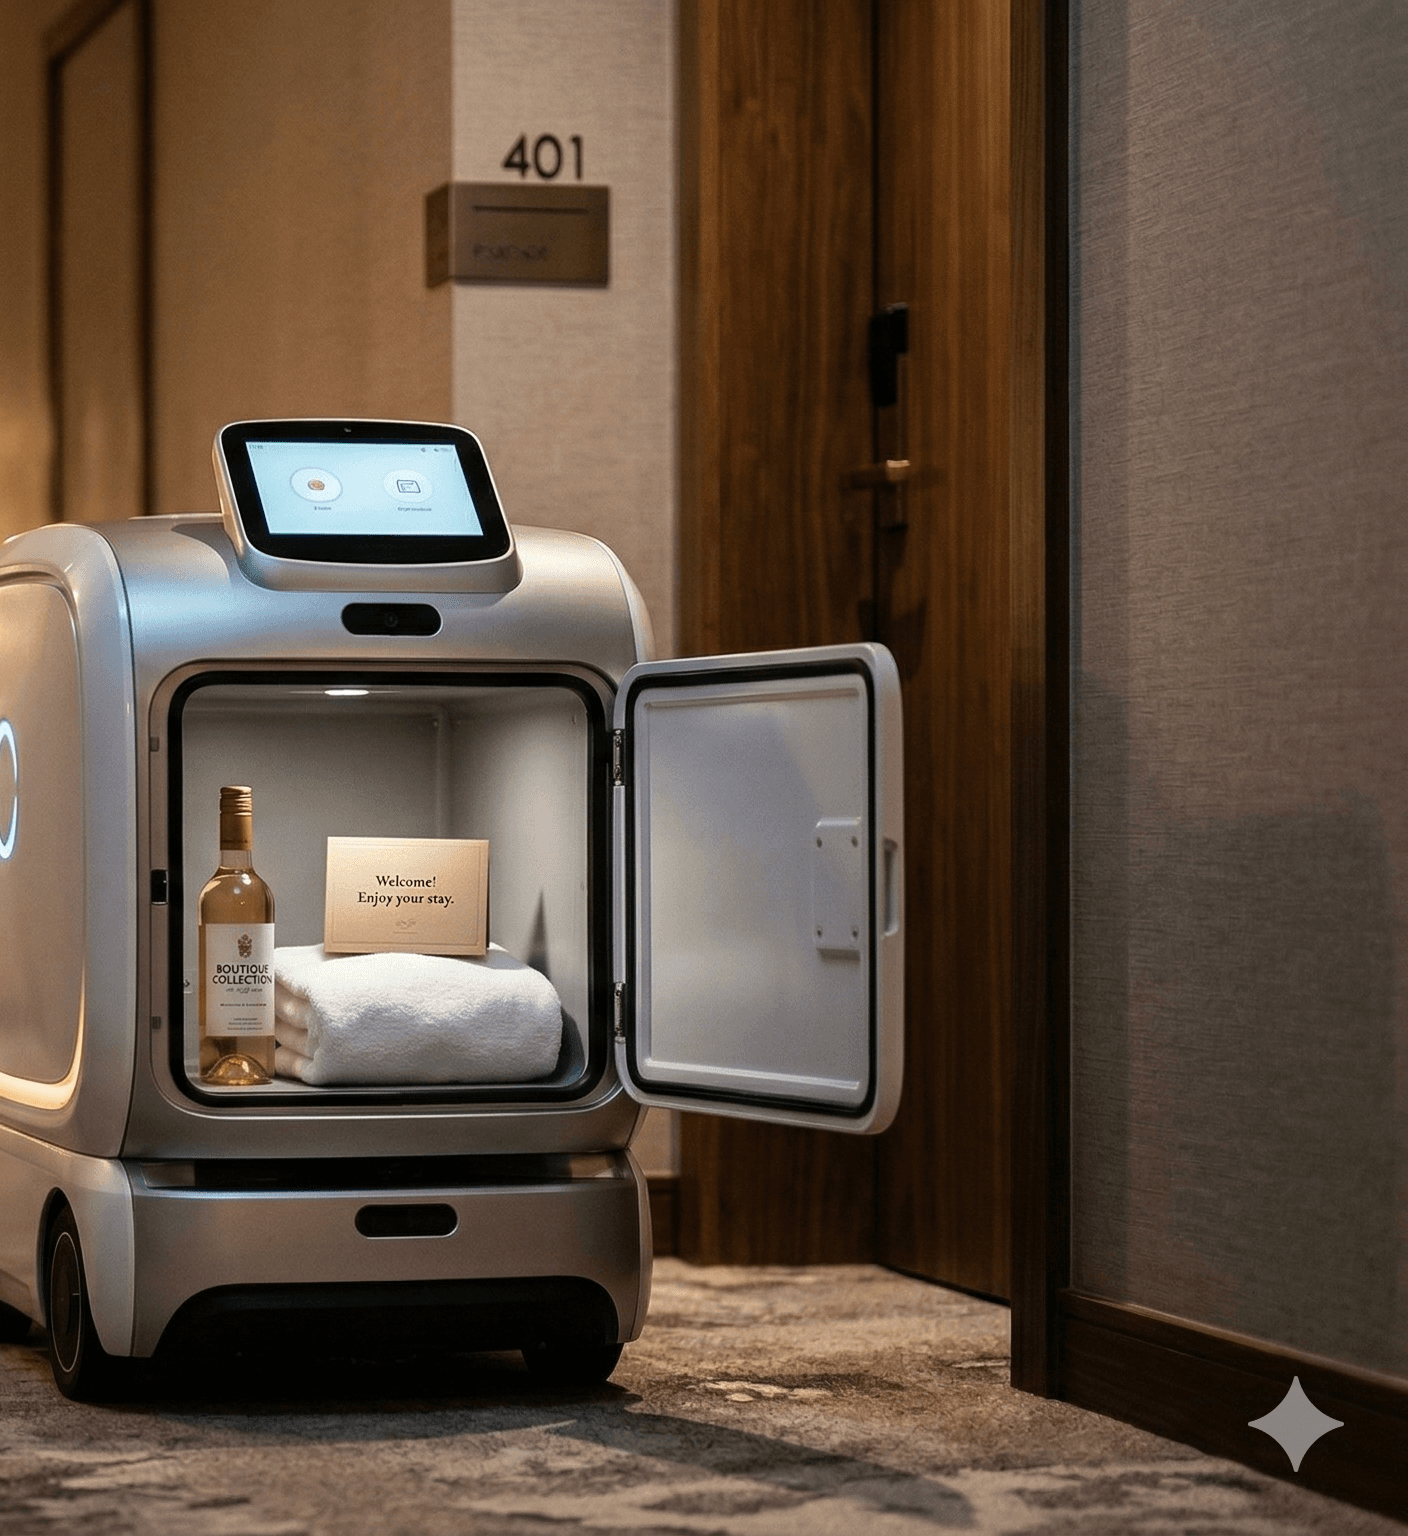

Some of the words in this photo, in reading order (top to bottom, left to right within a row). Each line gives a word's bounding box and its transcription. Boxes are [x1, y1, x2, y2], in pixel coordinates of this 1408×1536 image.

[501, 132, 583, 181] 401
[375, 875, 436, 888] Welcome!
[358, 891, 393, 907] Enjoy
[396, 895, 424, 907] your
[427, 895, 455, 908] stay.
[212, 975, 273, 985] COLLECTION
